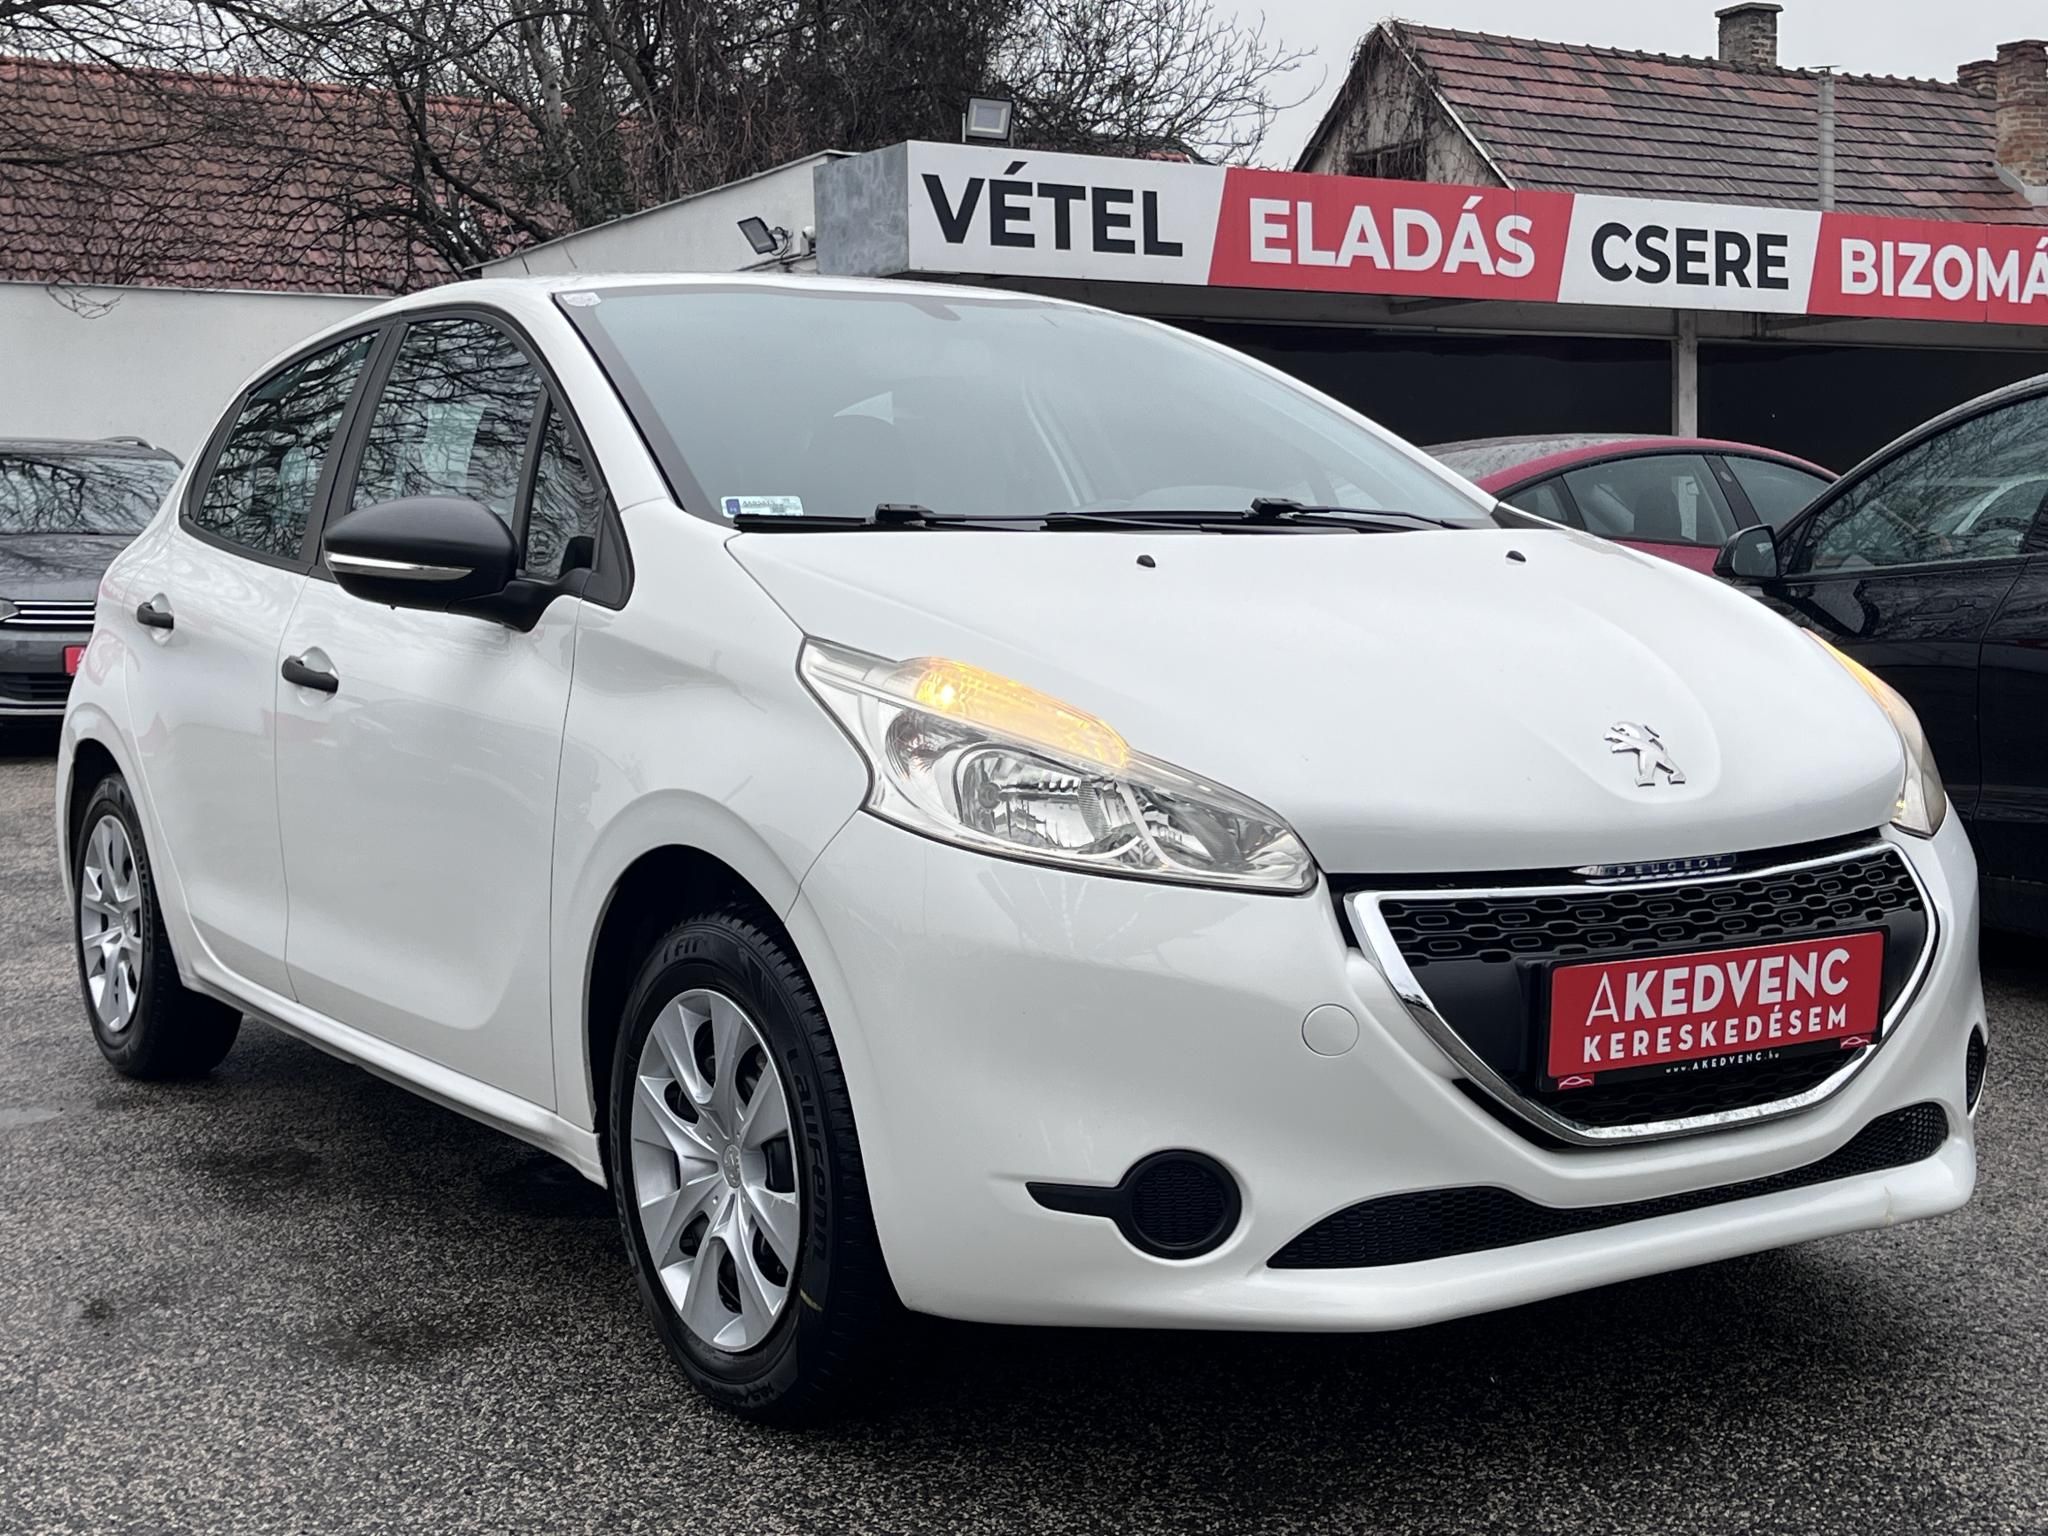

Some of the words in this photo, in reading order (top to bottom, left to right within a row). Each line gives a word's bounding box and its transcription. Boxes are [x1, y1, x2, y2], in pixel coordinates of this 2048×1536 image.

[921, 161, 1183, 257] VÉTEL
[1249, 195, 1536, 278] ELADÁS
[1591, 221, 1790, 290] CSERE
[1616, 856, 1724, 876] PEUGEOT
[1583, 1003, 1847, 1064] KERESKEDÉSEM
